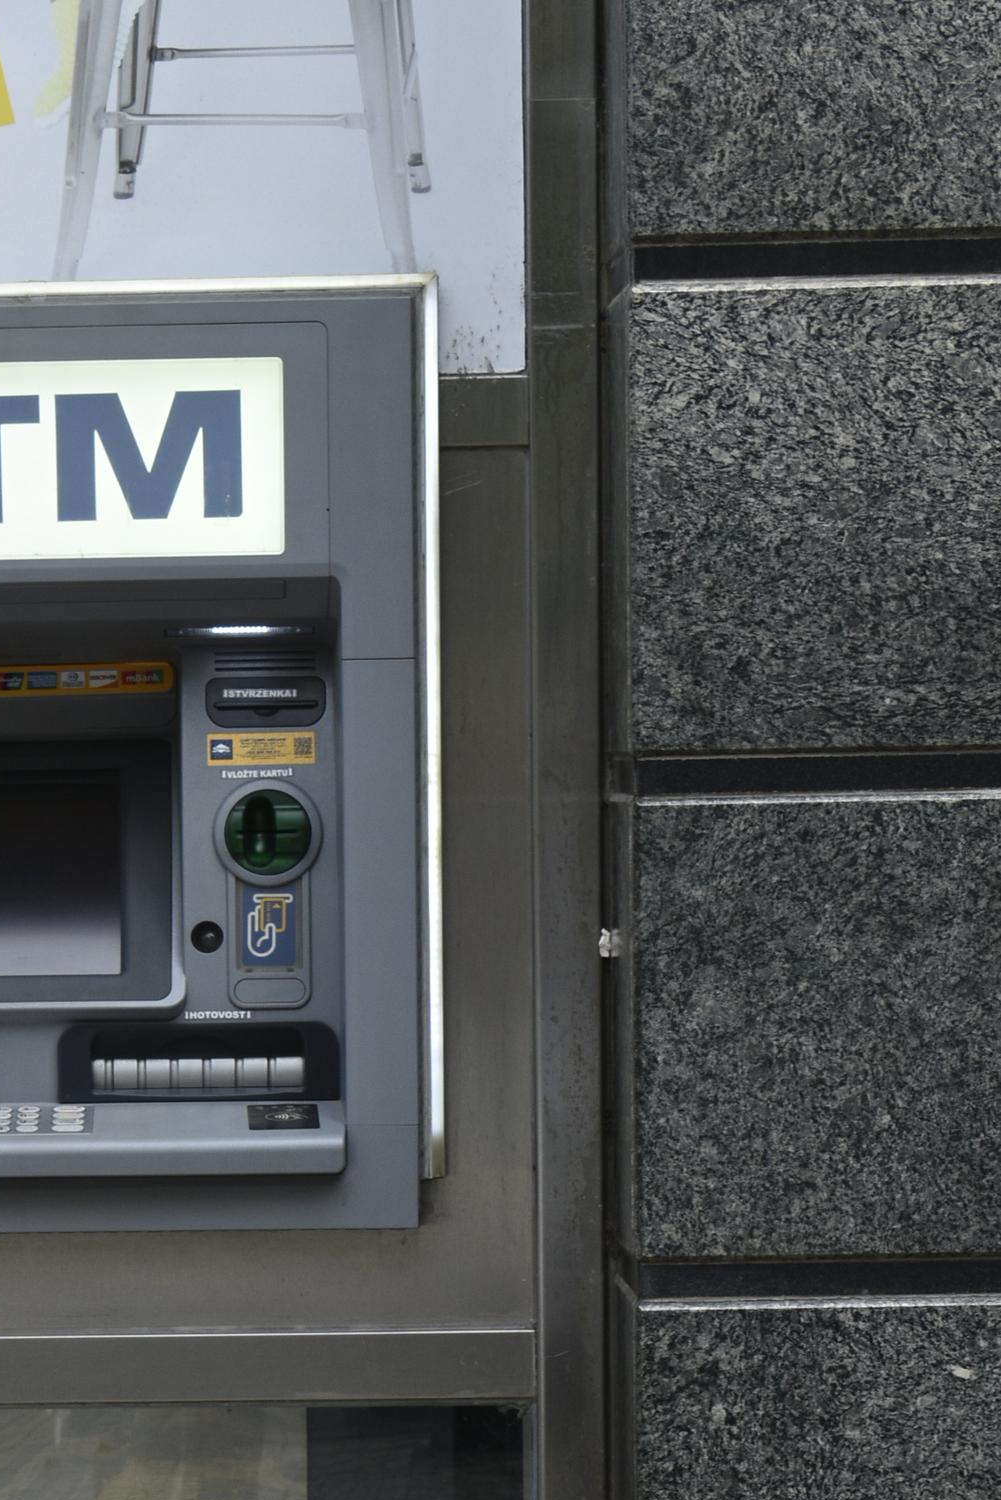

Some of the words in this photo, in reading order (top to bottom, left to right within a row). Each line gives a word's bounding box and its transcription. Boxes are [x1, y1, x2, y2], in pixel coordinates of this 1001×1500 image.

[125, 674, 161, 682] mBank
[260, 769, 288, 778] KARTU
[190, 1011, 246, 1020] HOTOVOST
